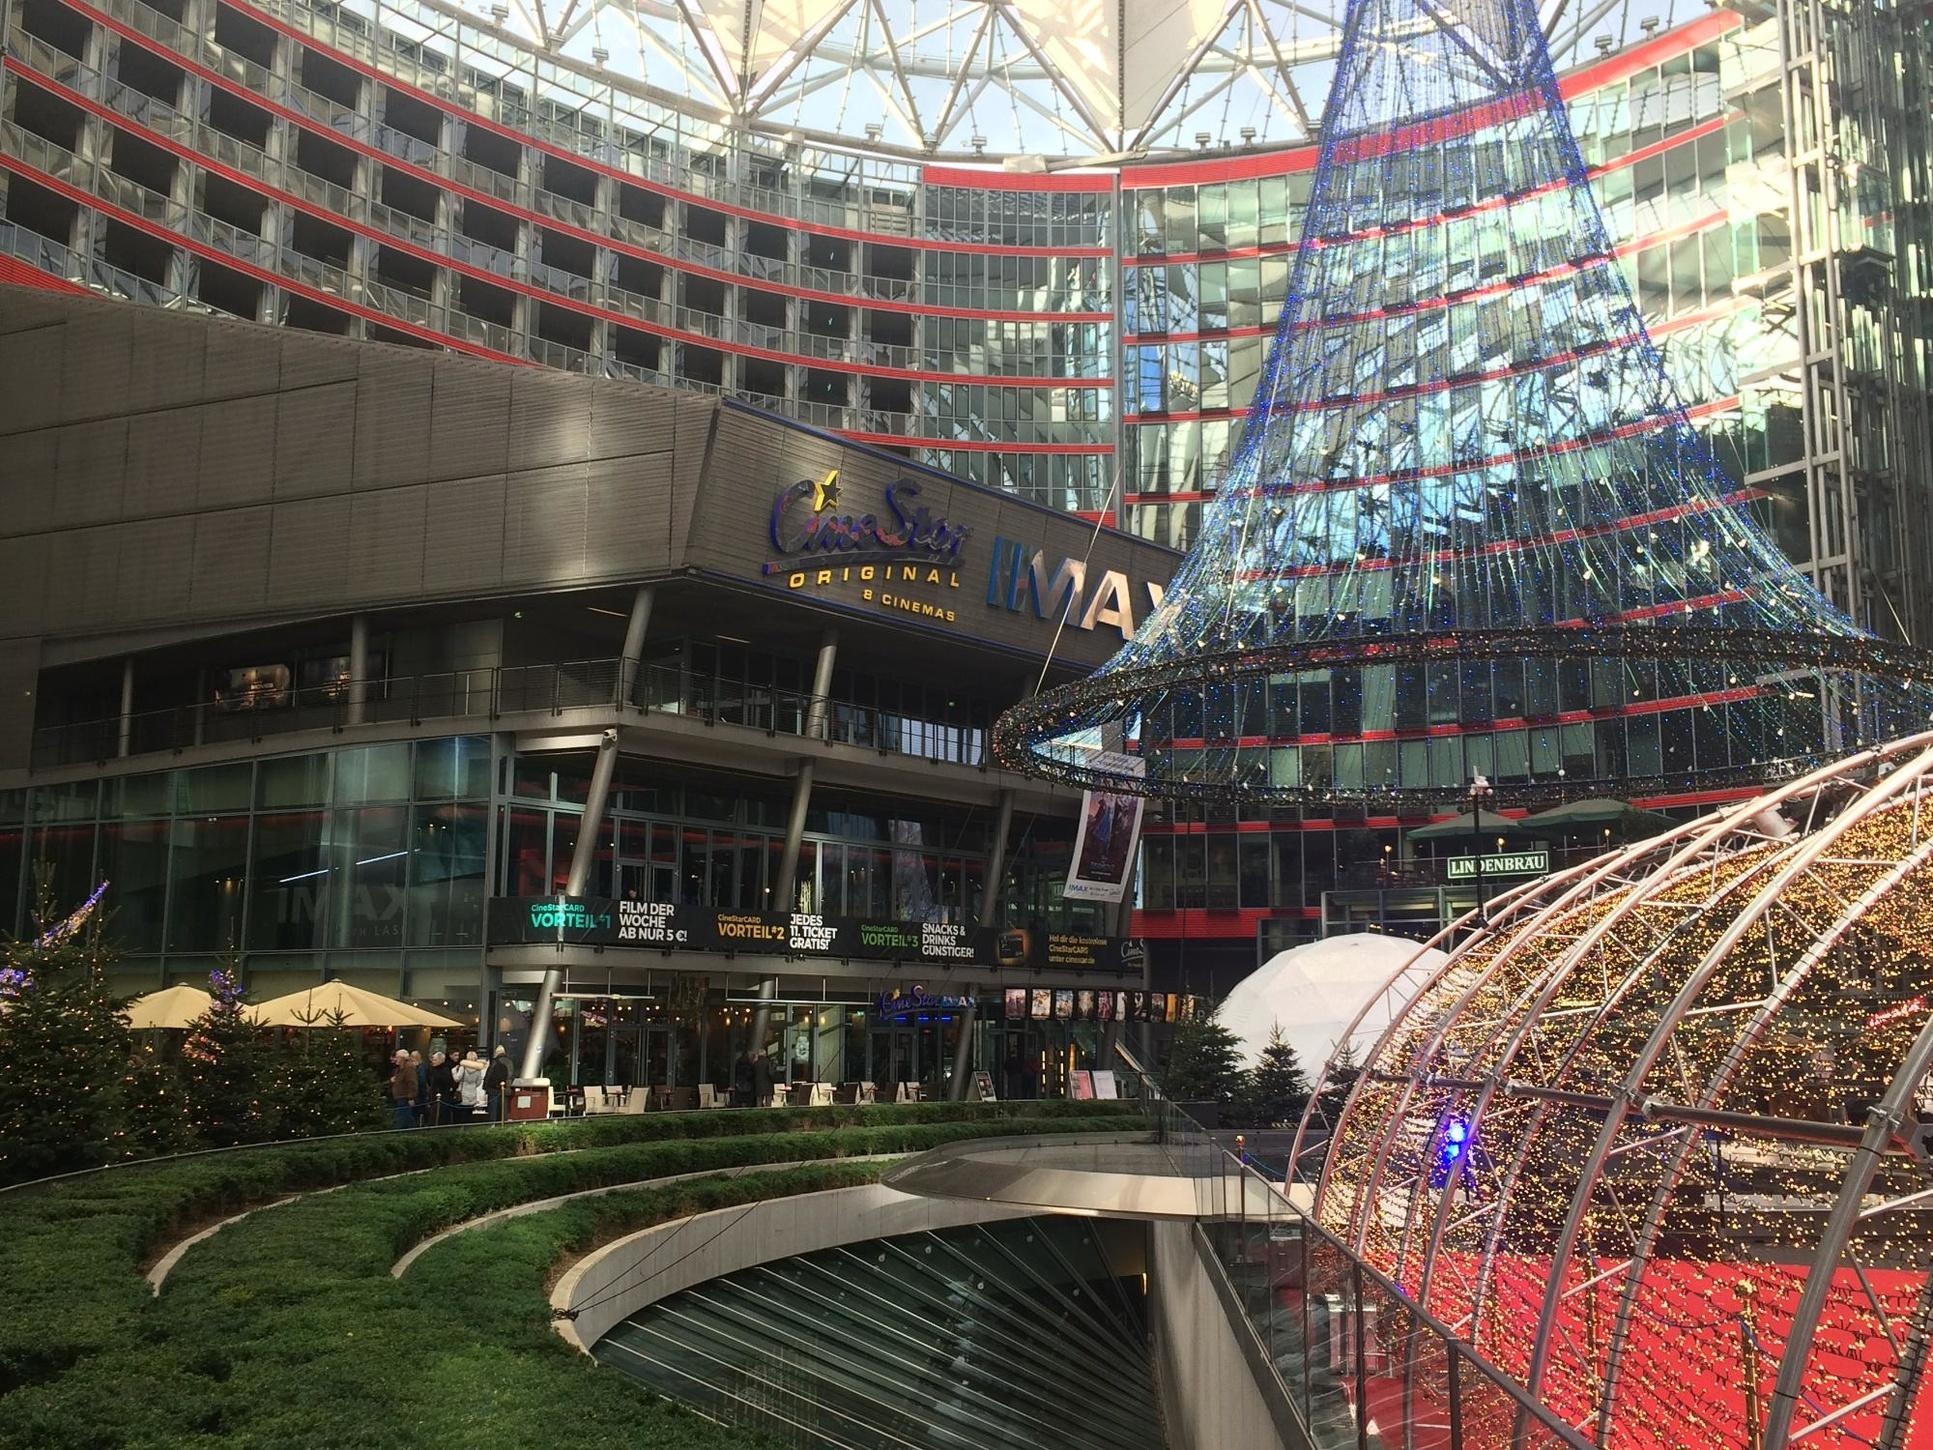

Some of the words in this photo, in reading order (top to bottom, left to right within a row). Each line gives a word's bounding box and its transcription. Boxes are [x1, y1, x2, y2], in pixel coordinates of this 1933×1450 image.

[789, 566, 960, 588] ORIGINAL
[882, 594, 956, 622] CINEMAS
[619, 901, 648, 914] FILM
[650, 903, 675, 917] DER
[619, 914, 666, 928] WOCHE
[790, 913, 823, 926] JEDES
[618, 928, 637, 940] AB
[638, 928, 664, 941] NUR
[802, 926, 838, 939] TICKET
[922, 922, 959, 936] SNACKS
[959, 925, 967, 937] &
[789, 937, 831, 950] GRATIS!
[922, 934, 956, 946] DRINKS
